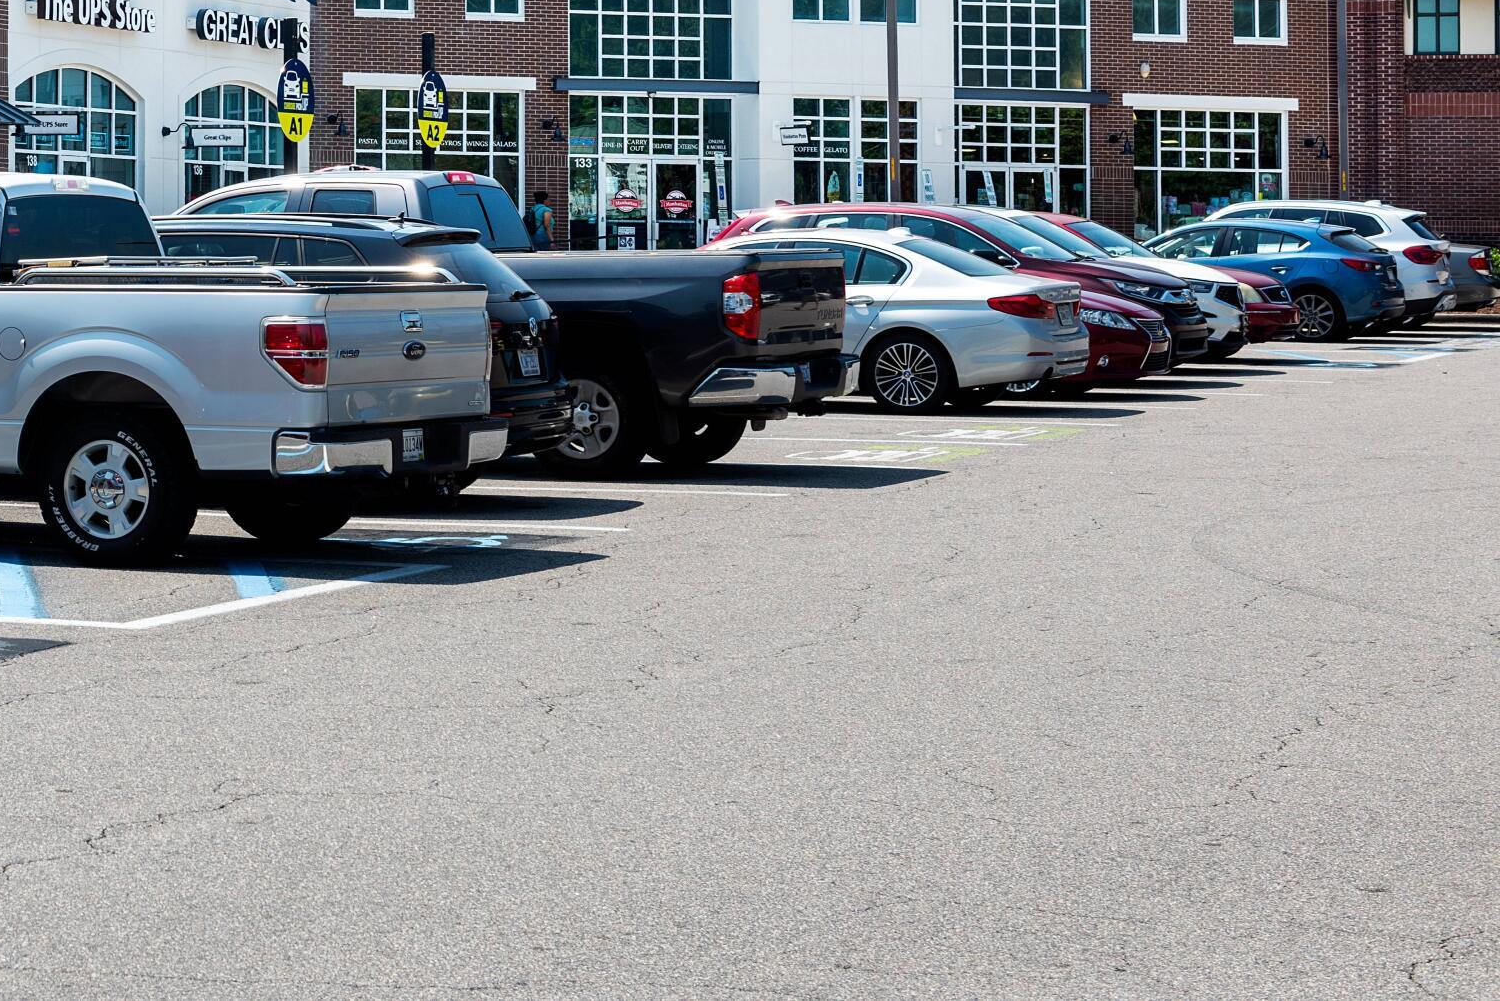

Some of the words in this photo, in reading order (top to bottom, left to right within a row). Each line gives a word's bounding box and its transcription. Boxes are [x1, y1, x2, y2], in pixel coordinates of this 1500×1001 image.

[201, 9, 258, 45] GREAT
[289, 117, 302, 135] A1
[427, 124, 439, 141] A2
[493, 140, 517, 148] SALADS
[27, 155, 38, 167] 138
[574, 158, 592, 168] 133
[117, 431, 157, 487] GENERAL
[52, 506, 99, 551] GRABBER
